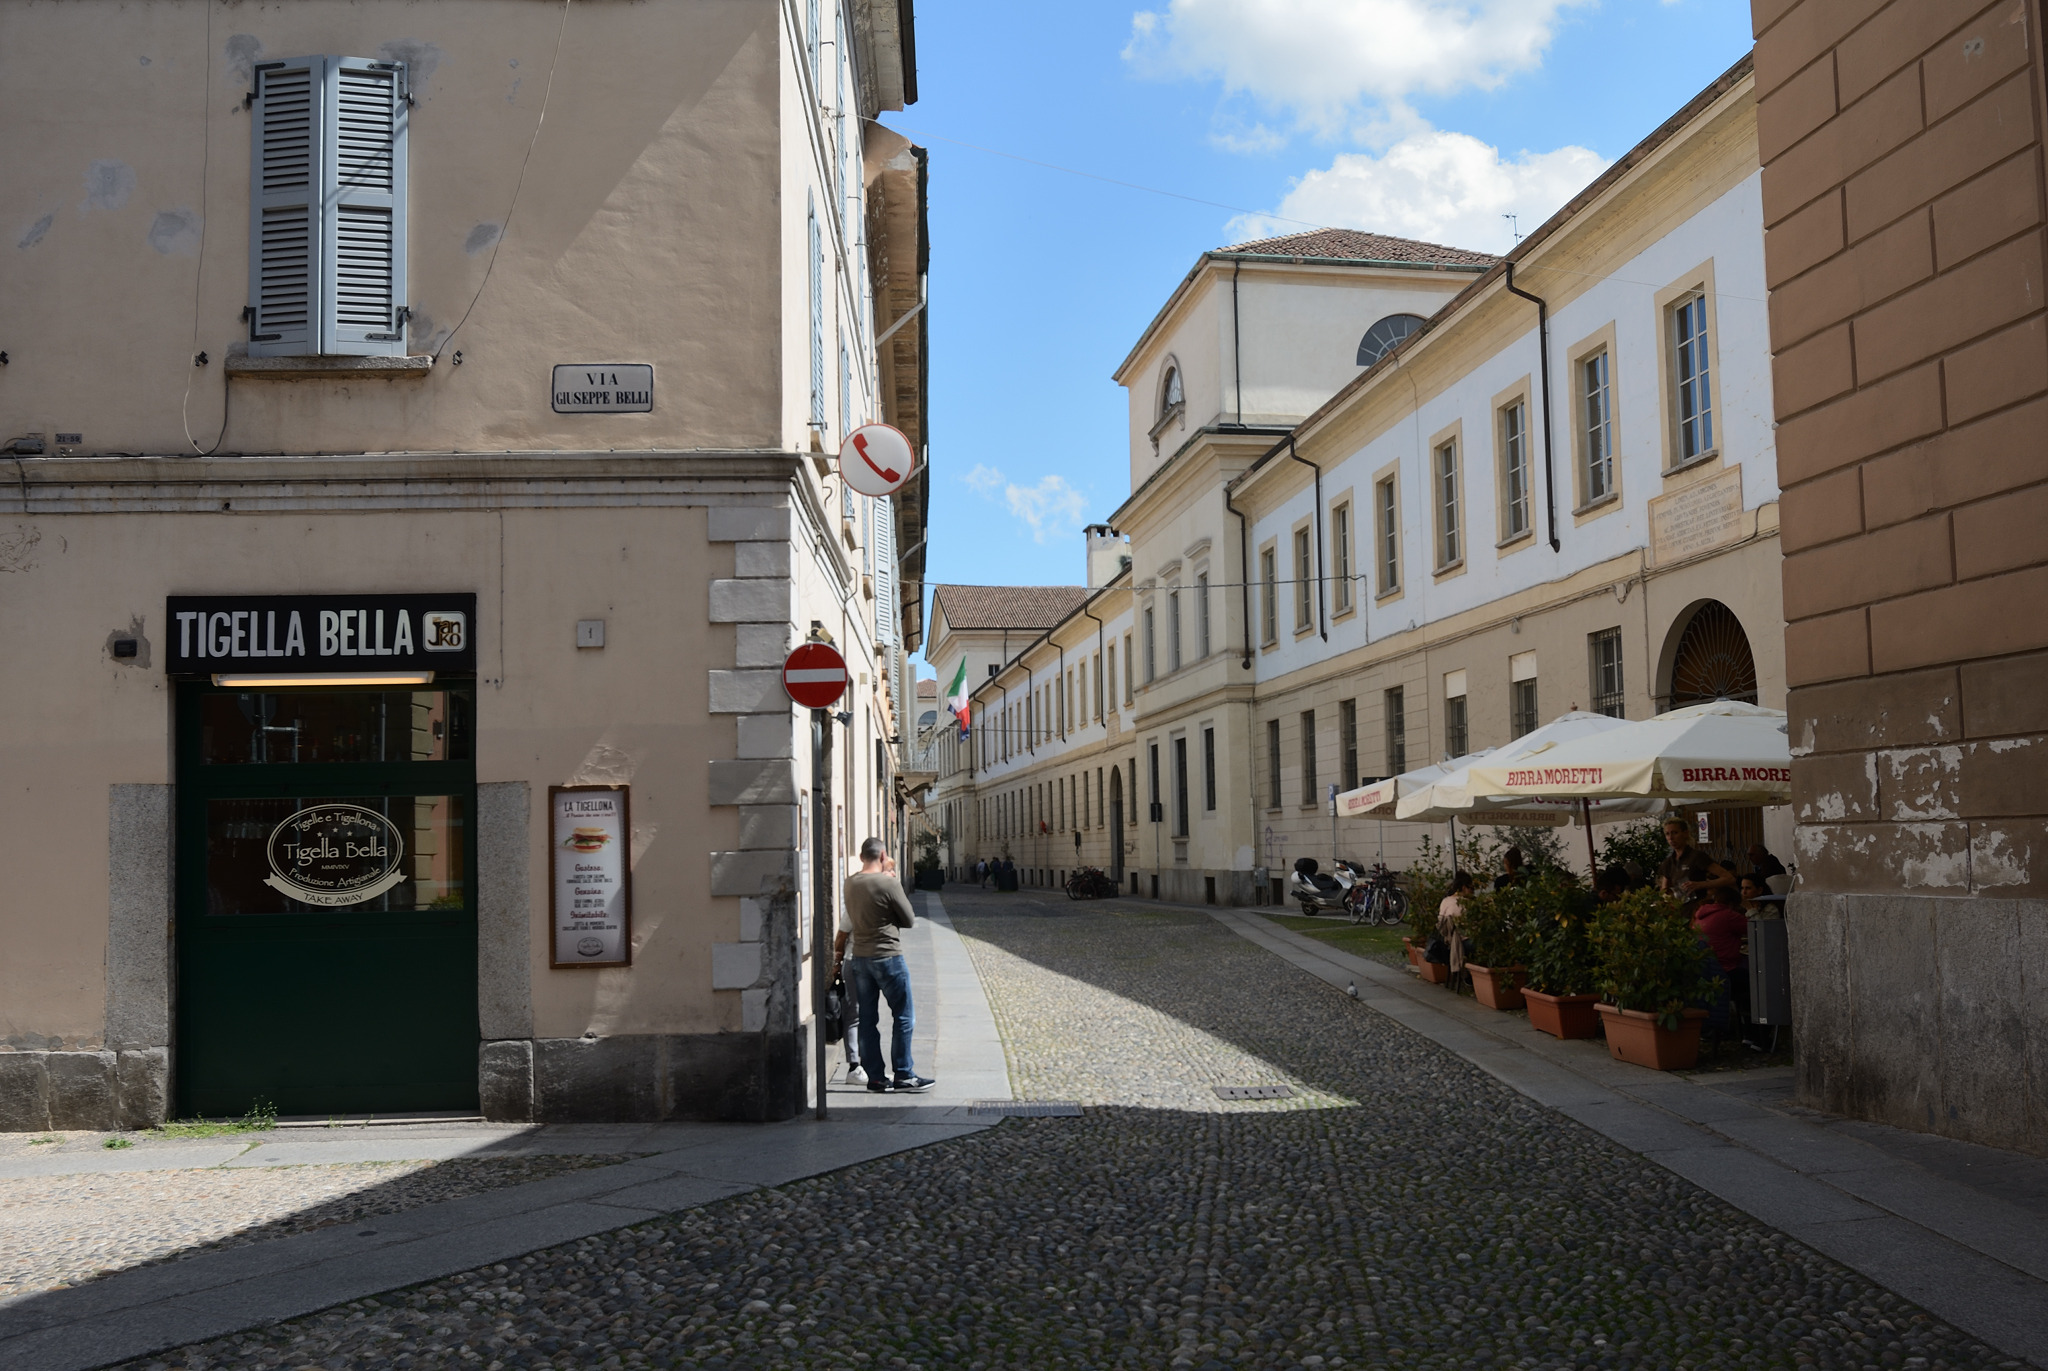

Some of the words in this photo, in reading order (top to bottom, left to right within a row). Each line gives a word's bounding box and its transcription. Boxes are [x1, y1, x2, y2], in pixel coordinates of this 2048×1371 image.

[586, 372, 619, 386] VIA
[556, 391, 610, 405] GIUSEPPE
[616, 391, 649, 404] BELLI
[175, 610, 306, 658] TIGELLA
[319, 608, 414, 657] BELLA
[1505, 771, 1544, 787] BIRRA
[1544, 767, 1603, 785] MORETTI
[1682, 767, 1741, 782] BIRRA
[564, 801, 573, 812] LA
[576, 800, 613, 812] TIGELLONA
[290, 812, 324, 832] Tigelle
[283, 836, 340, 867] Tigella
[345, 836, 387, 858] Bella
[288, 867, 335, 886] Produzione
[336, 867, 382, 888] Artigianale
[303, 892, 333, 904] TAKE
[334, 892, 363, 904] AWAY
